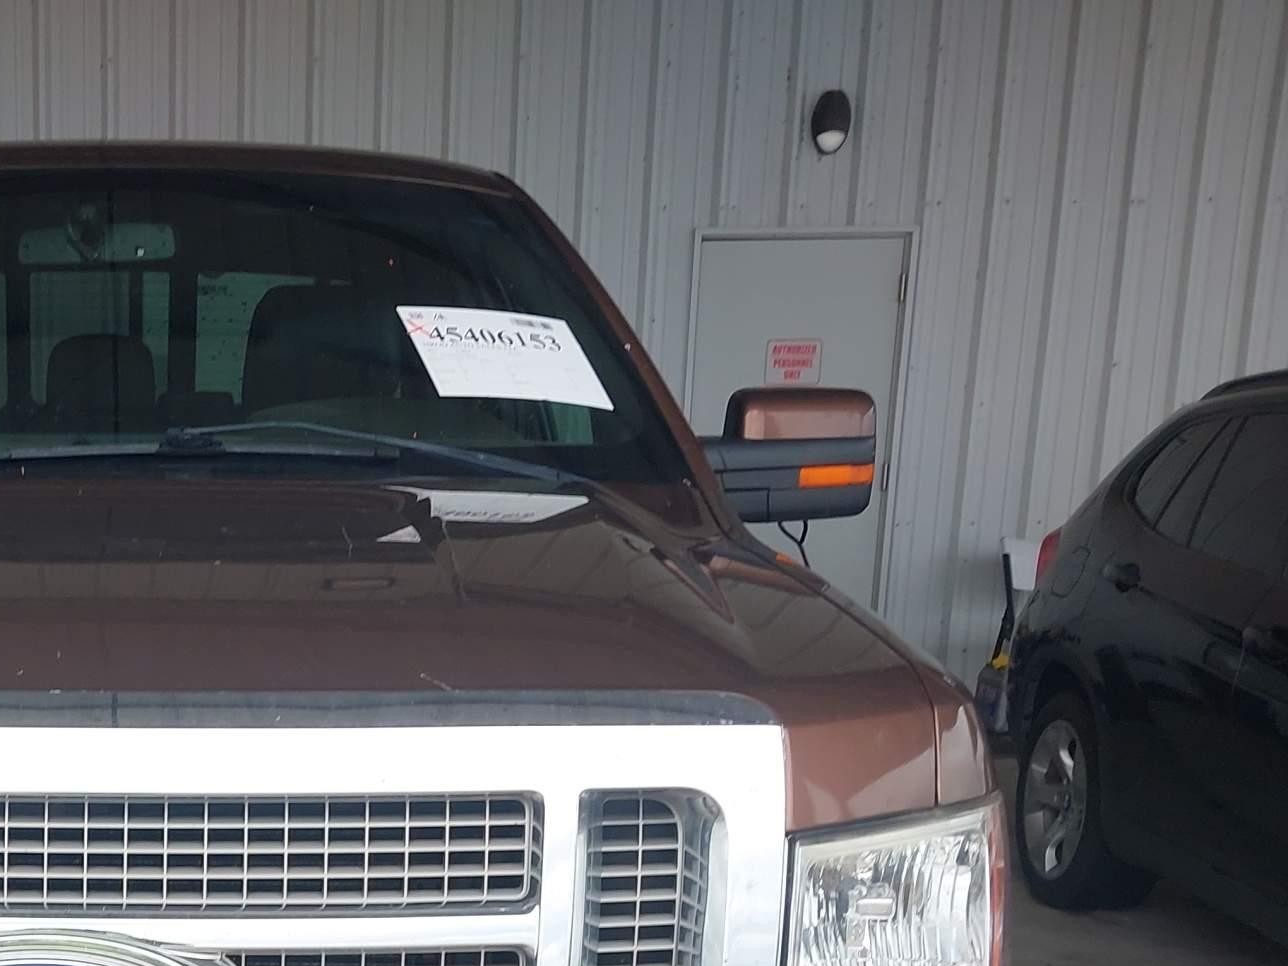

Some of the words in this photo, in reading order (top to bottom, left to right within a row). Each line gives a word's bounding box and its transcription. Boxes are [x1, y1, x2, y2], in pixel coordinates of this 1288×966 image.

[429, 326, 561, 352] 45406153
[772, 344, 817, 354] AUTHORIZED
[773, 359, 813, 369] PERSONNEL
